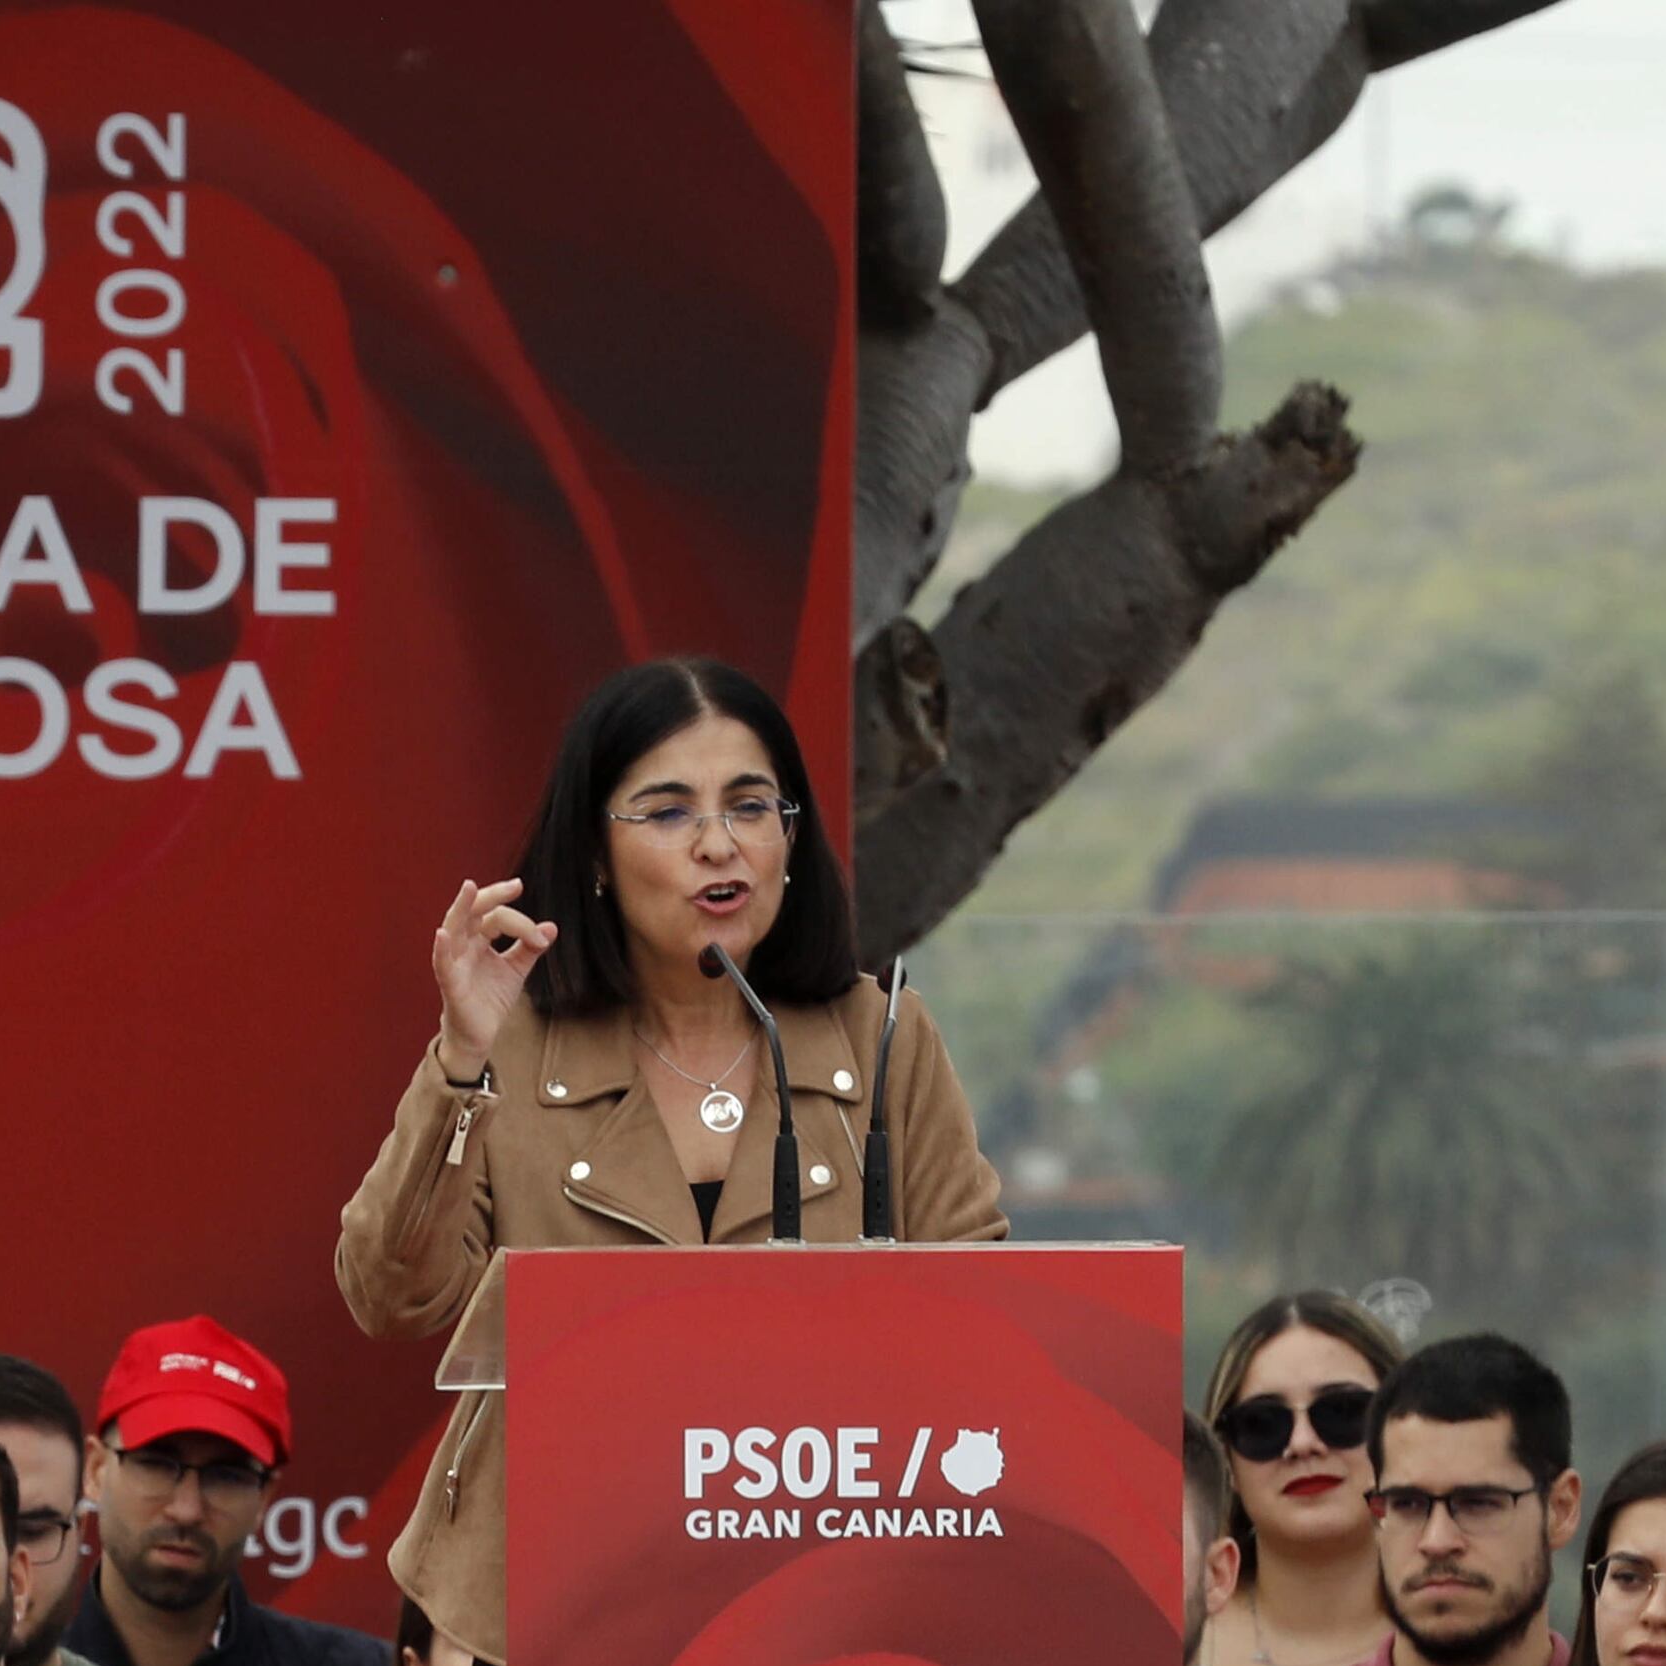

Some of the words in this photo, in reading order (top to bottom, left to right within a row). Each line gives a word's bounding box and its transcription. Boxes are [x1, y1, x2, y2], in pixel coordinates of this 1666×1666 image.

[94, 111, 187, 416] 2022
[137, 495, 338, 616] DE
[683, 1425, 881, 1500] PSOE
[684, 1508, 802, 1541] GRAN
[815, 1507, 1005, 1539] CANARIA
